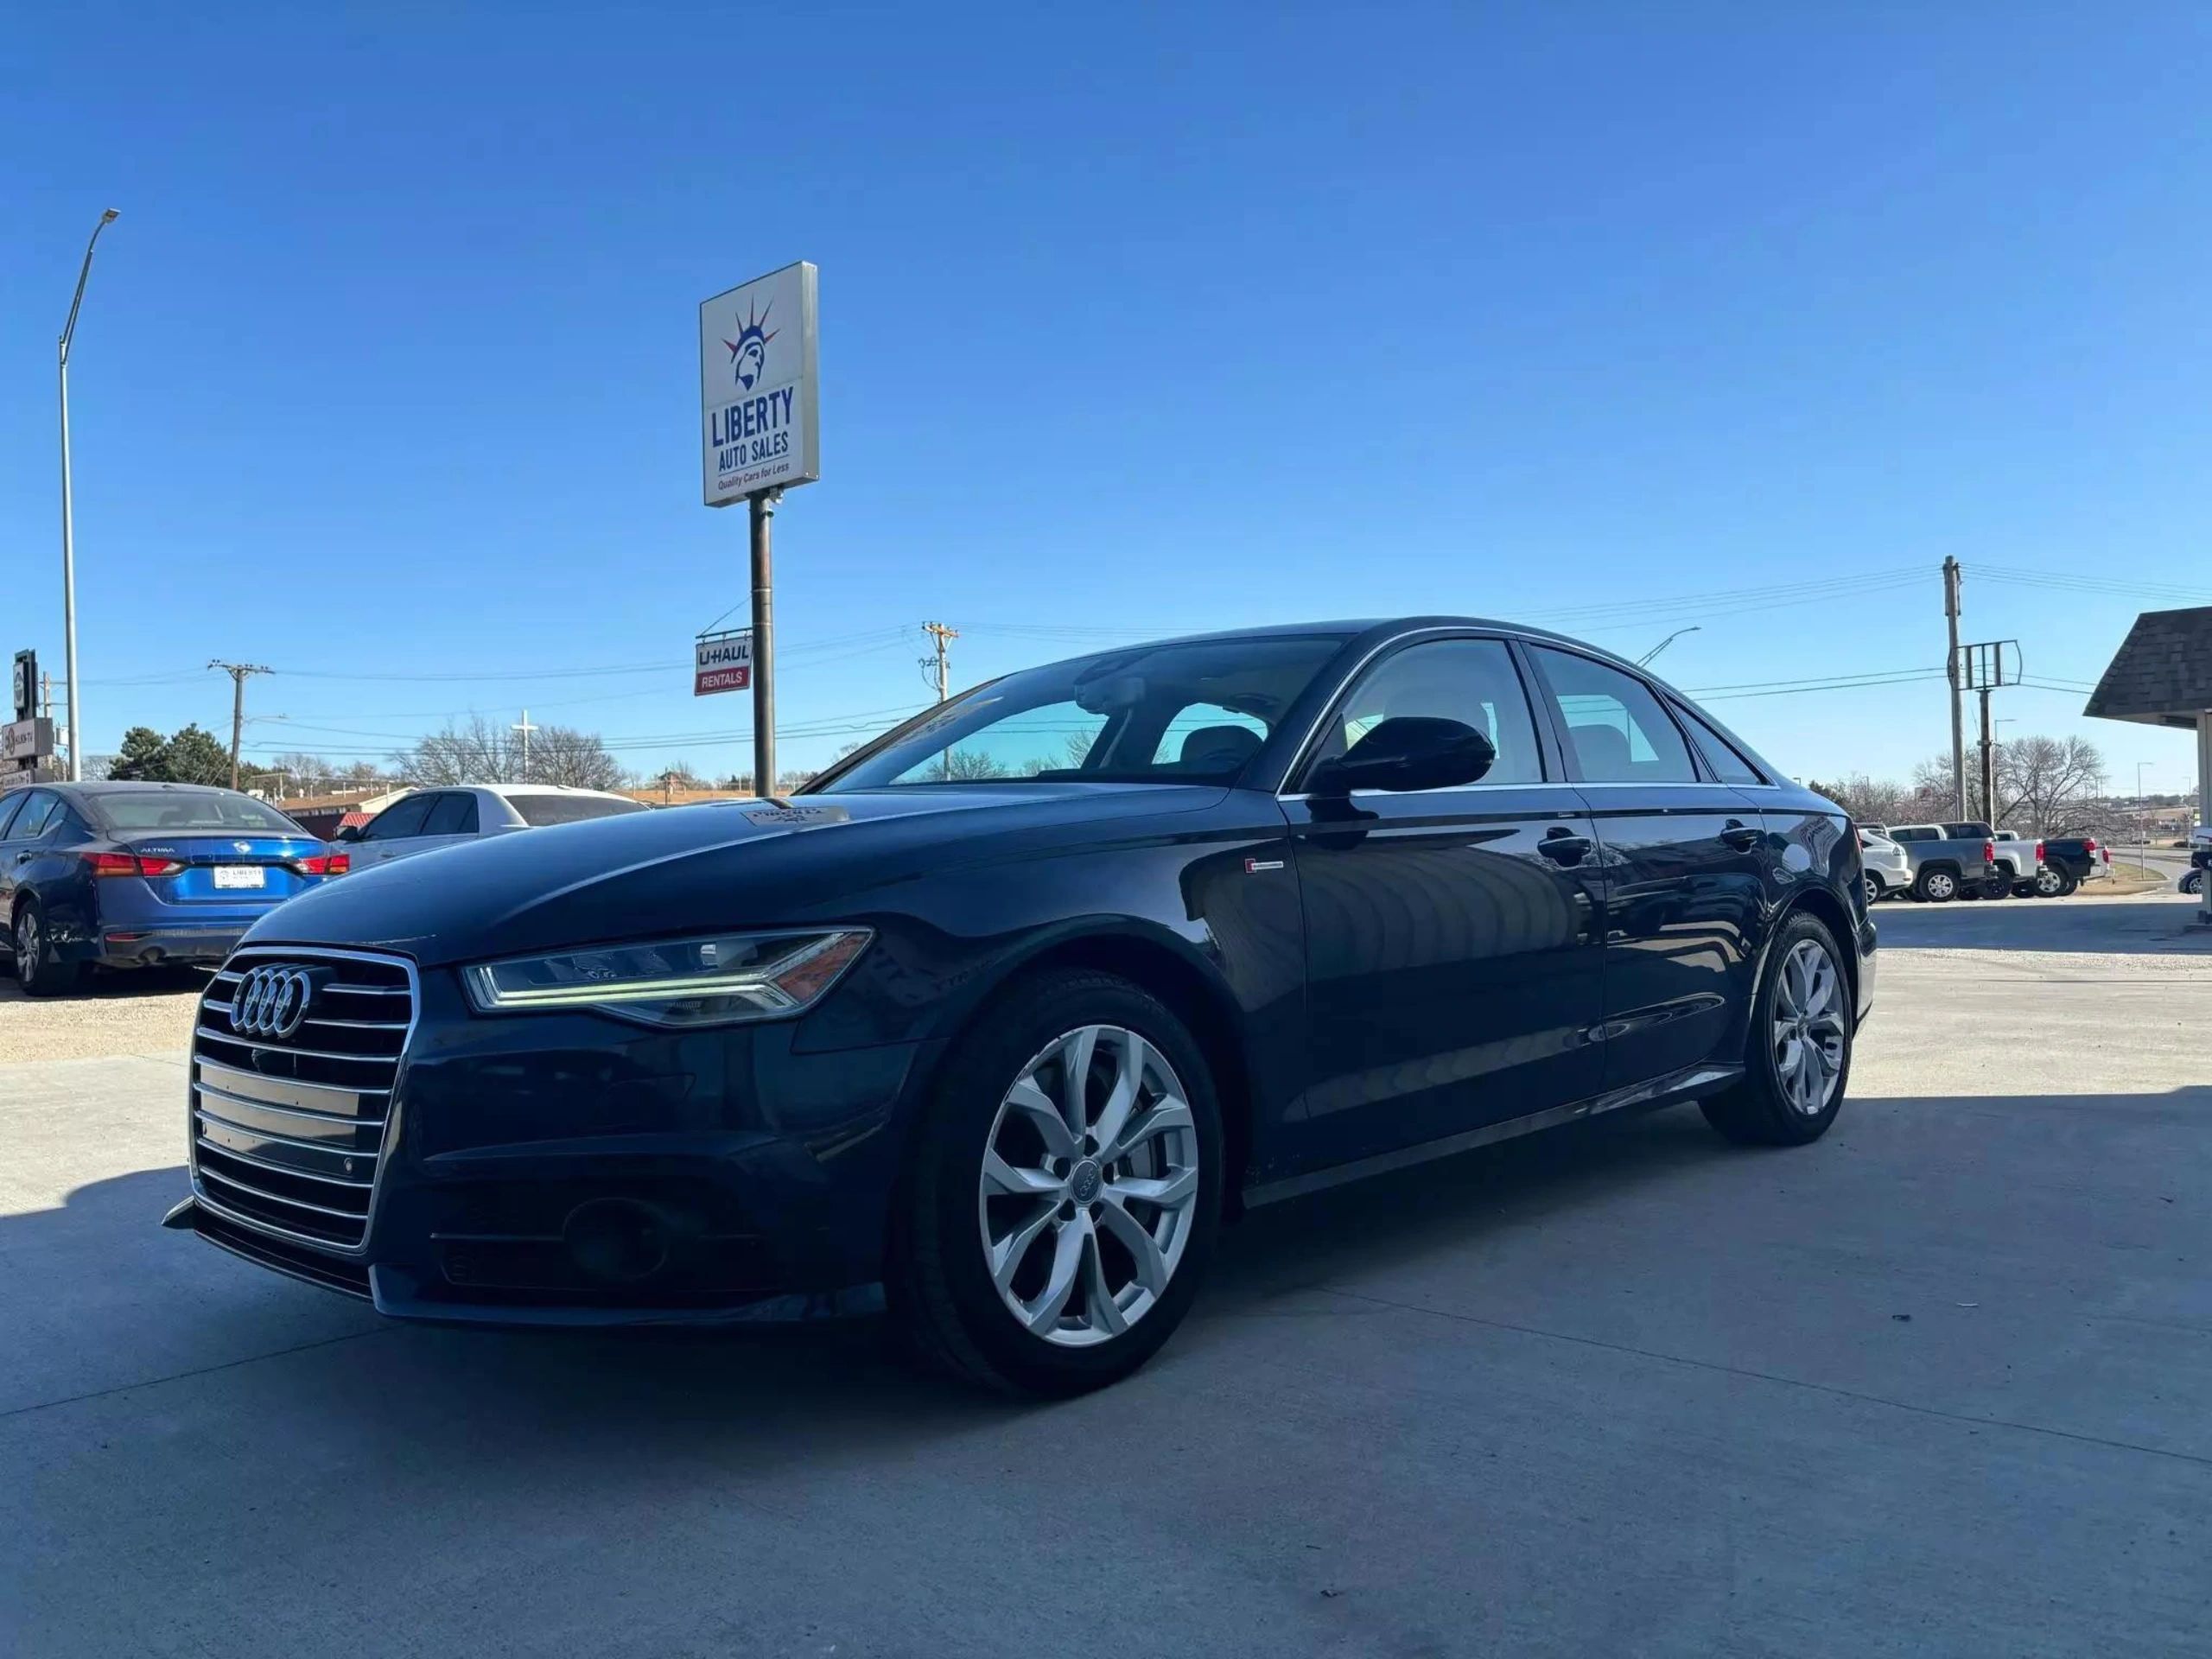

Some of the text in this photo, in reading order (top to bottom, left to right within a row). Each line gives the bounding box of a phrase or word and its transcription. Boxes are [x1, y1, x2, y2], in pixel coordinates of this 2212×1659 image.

[712, 386, 793, 448] LIBERTY
[719, 431, 788, 472] AUTO SALES
[719, 463, 789, 490] Quality Cars for Less
[699, 645, 749, 665] U-HAUL
[702, 671, 742, 689] RENTALS
